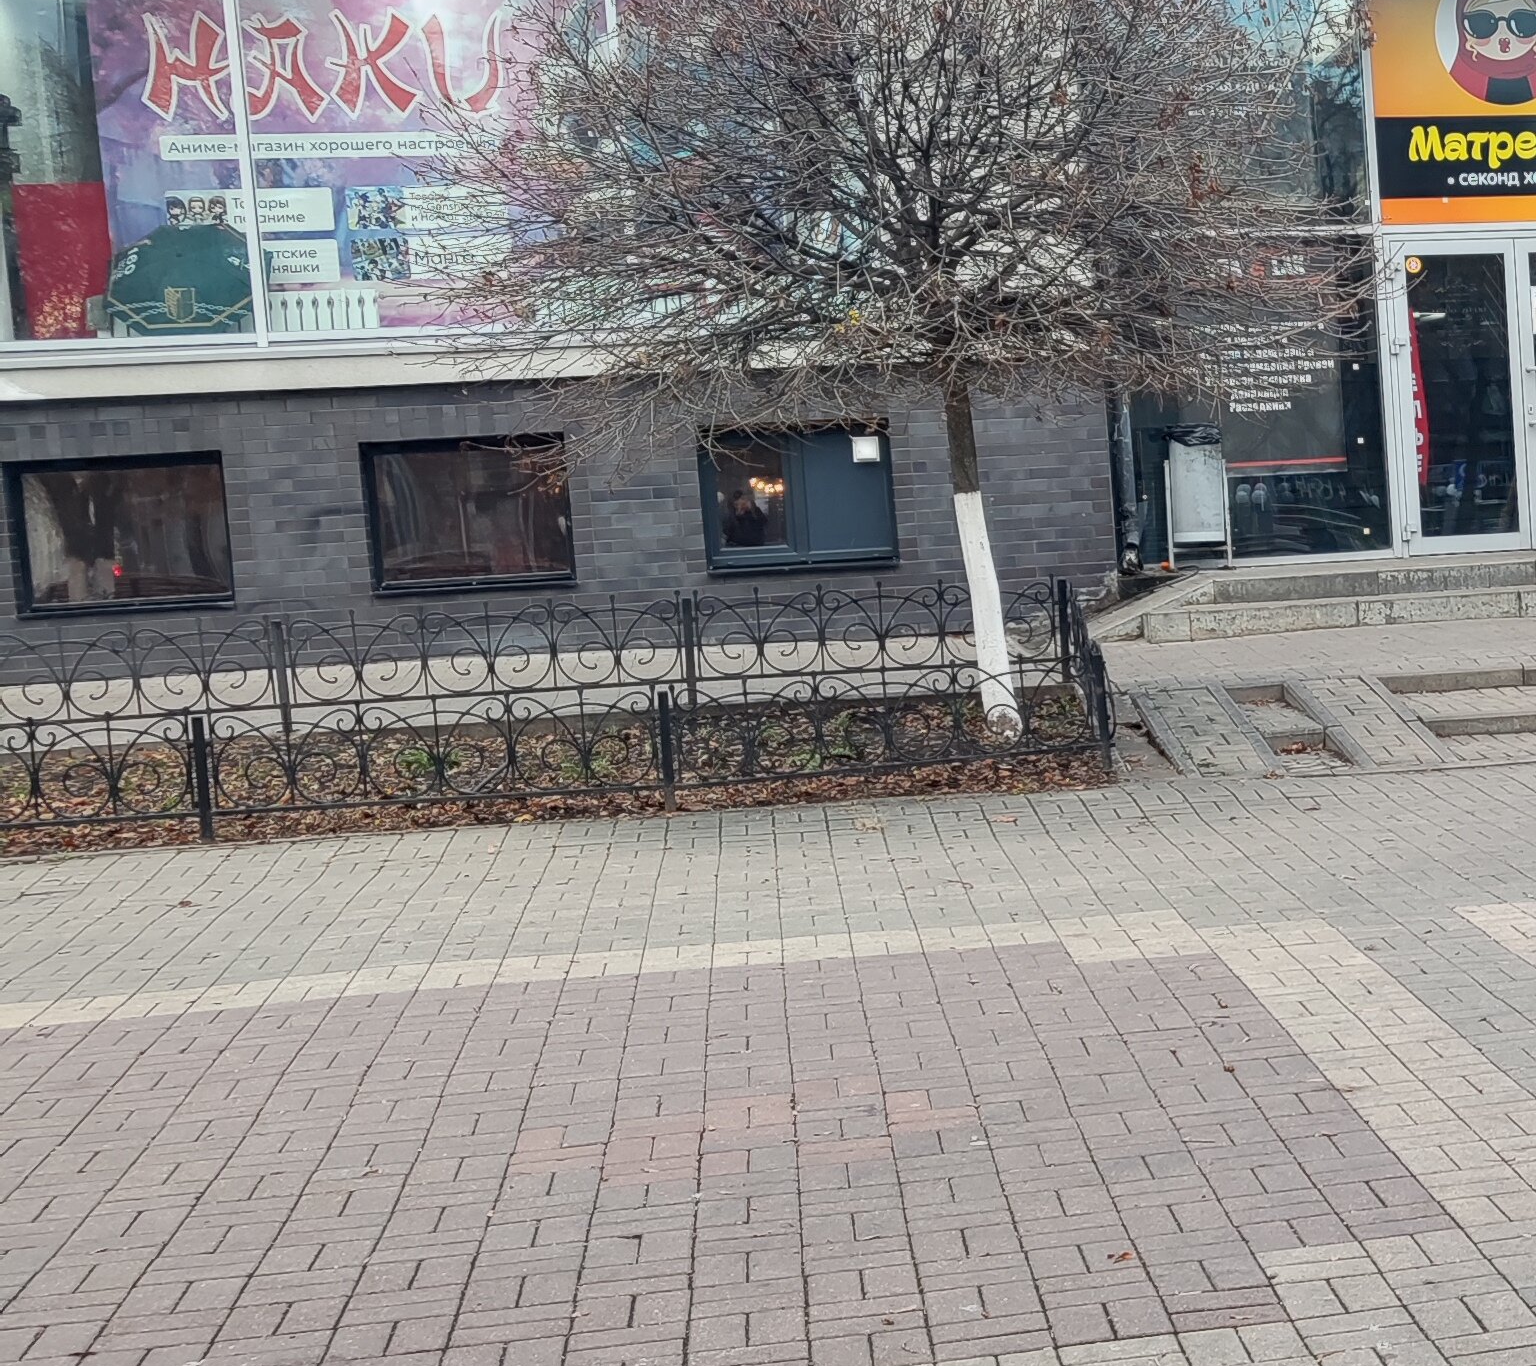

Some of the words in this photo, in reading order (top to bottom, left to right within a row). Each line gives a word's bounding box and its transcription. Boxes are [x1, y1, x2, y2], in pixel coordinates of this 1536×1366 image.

[141, 5, 504, 123] HAKU
[168, 140, 305, 154] Аниме-газин
[309, 138, 392, 154] хорошего
[1458, 172, 1520, 187] секонд
[231, 197, 290, 212] Тоары
